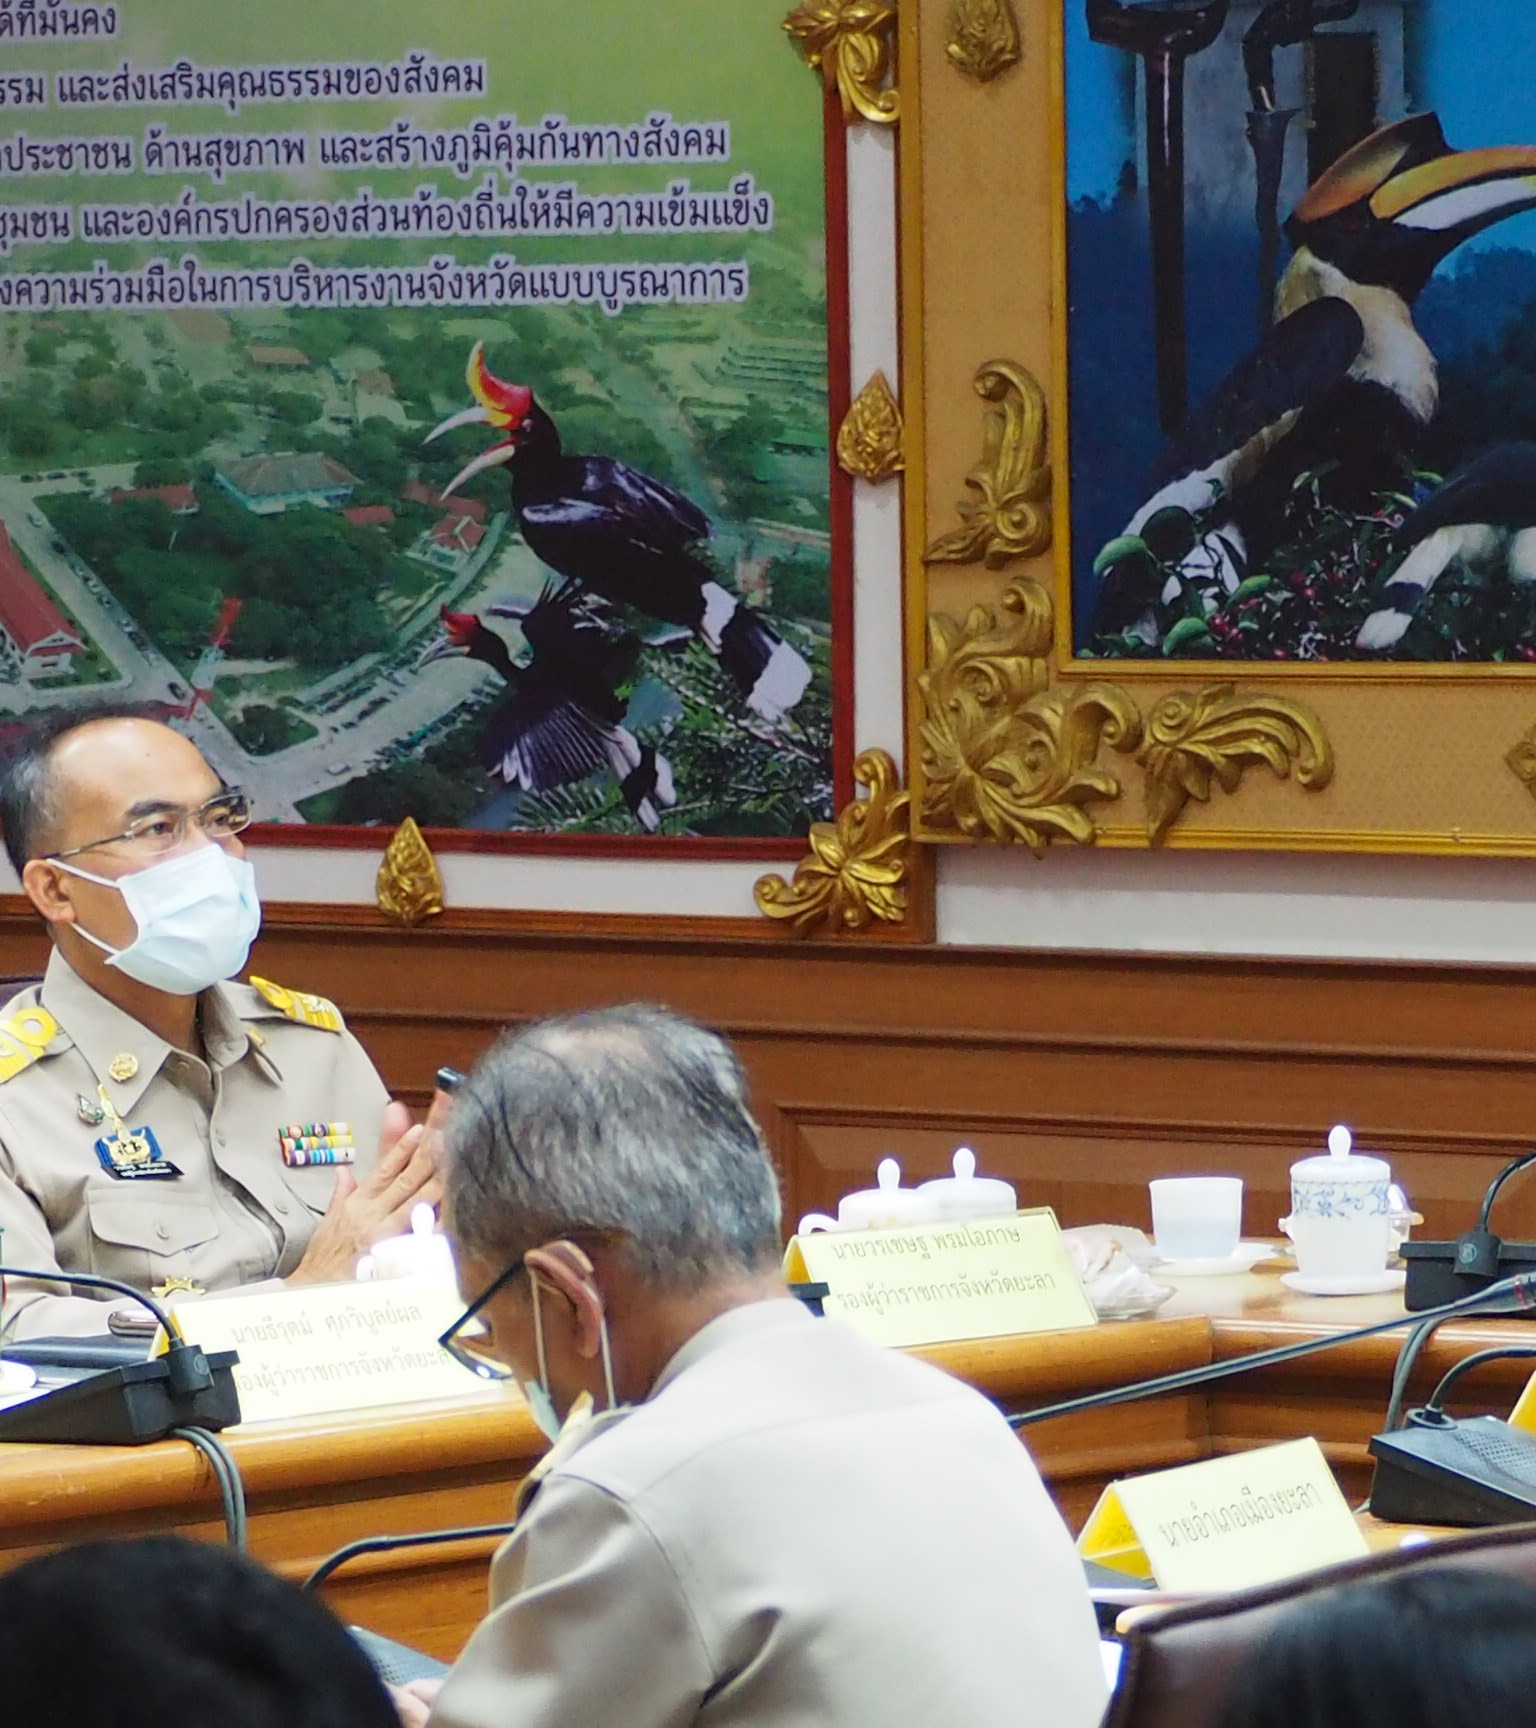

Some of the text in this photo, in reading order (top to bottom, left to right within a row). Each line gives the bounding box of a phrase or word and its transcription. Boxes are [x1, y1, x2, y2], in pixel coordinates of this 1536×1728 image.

[58, 56, 485, 109] และส่งเสริมคุณธรรมของสังคม
[145, 129, 305, 182] ด้านสุขภาพ
[319, 119, 727, 178] และสร้างภูมิคุ้มกันทางสังคม
[82, 180, 769, 240] และองค์กรปกครองส่วนท้องถิ่นให้มีความเข้มแข็ง
[836, 1270, 1057, 1315] รองผู้ว่าราชการจังหวัดยะลา
[234, 1346, 450, 1397] องผู้ว่าราชการจังหวัดยะล
[1158, 1484, 1323, 1548] นายอำเภอเมืองยะลา
